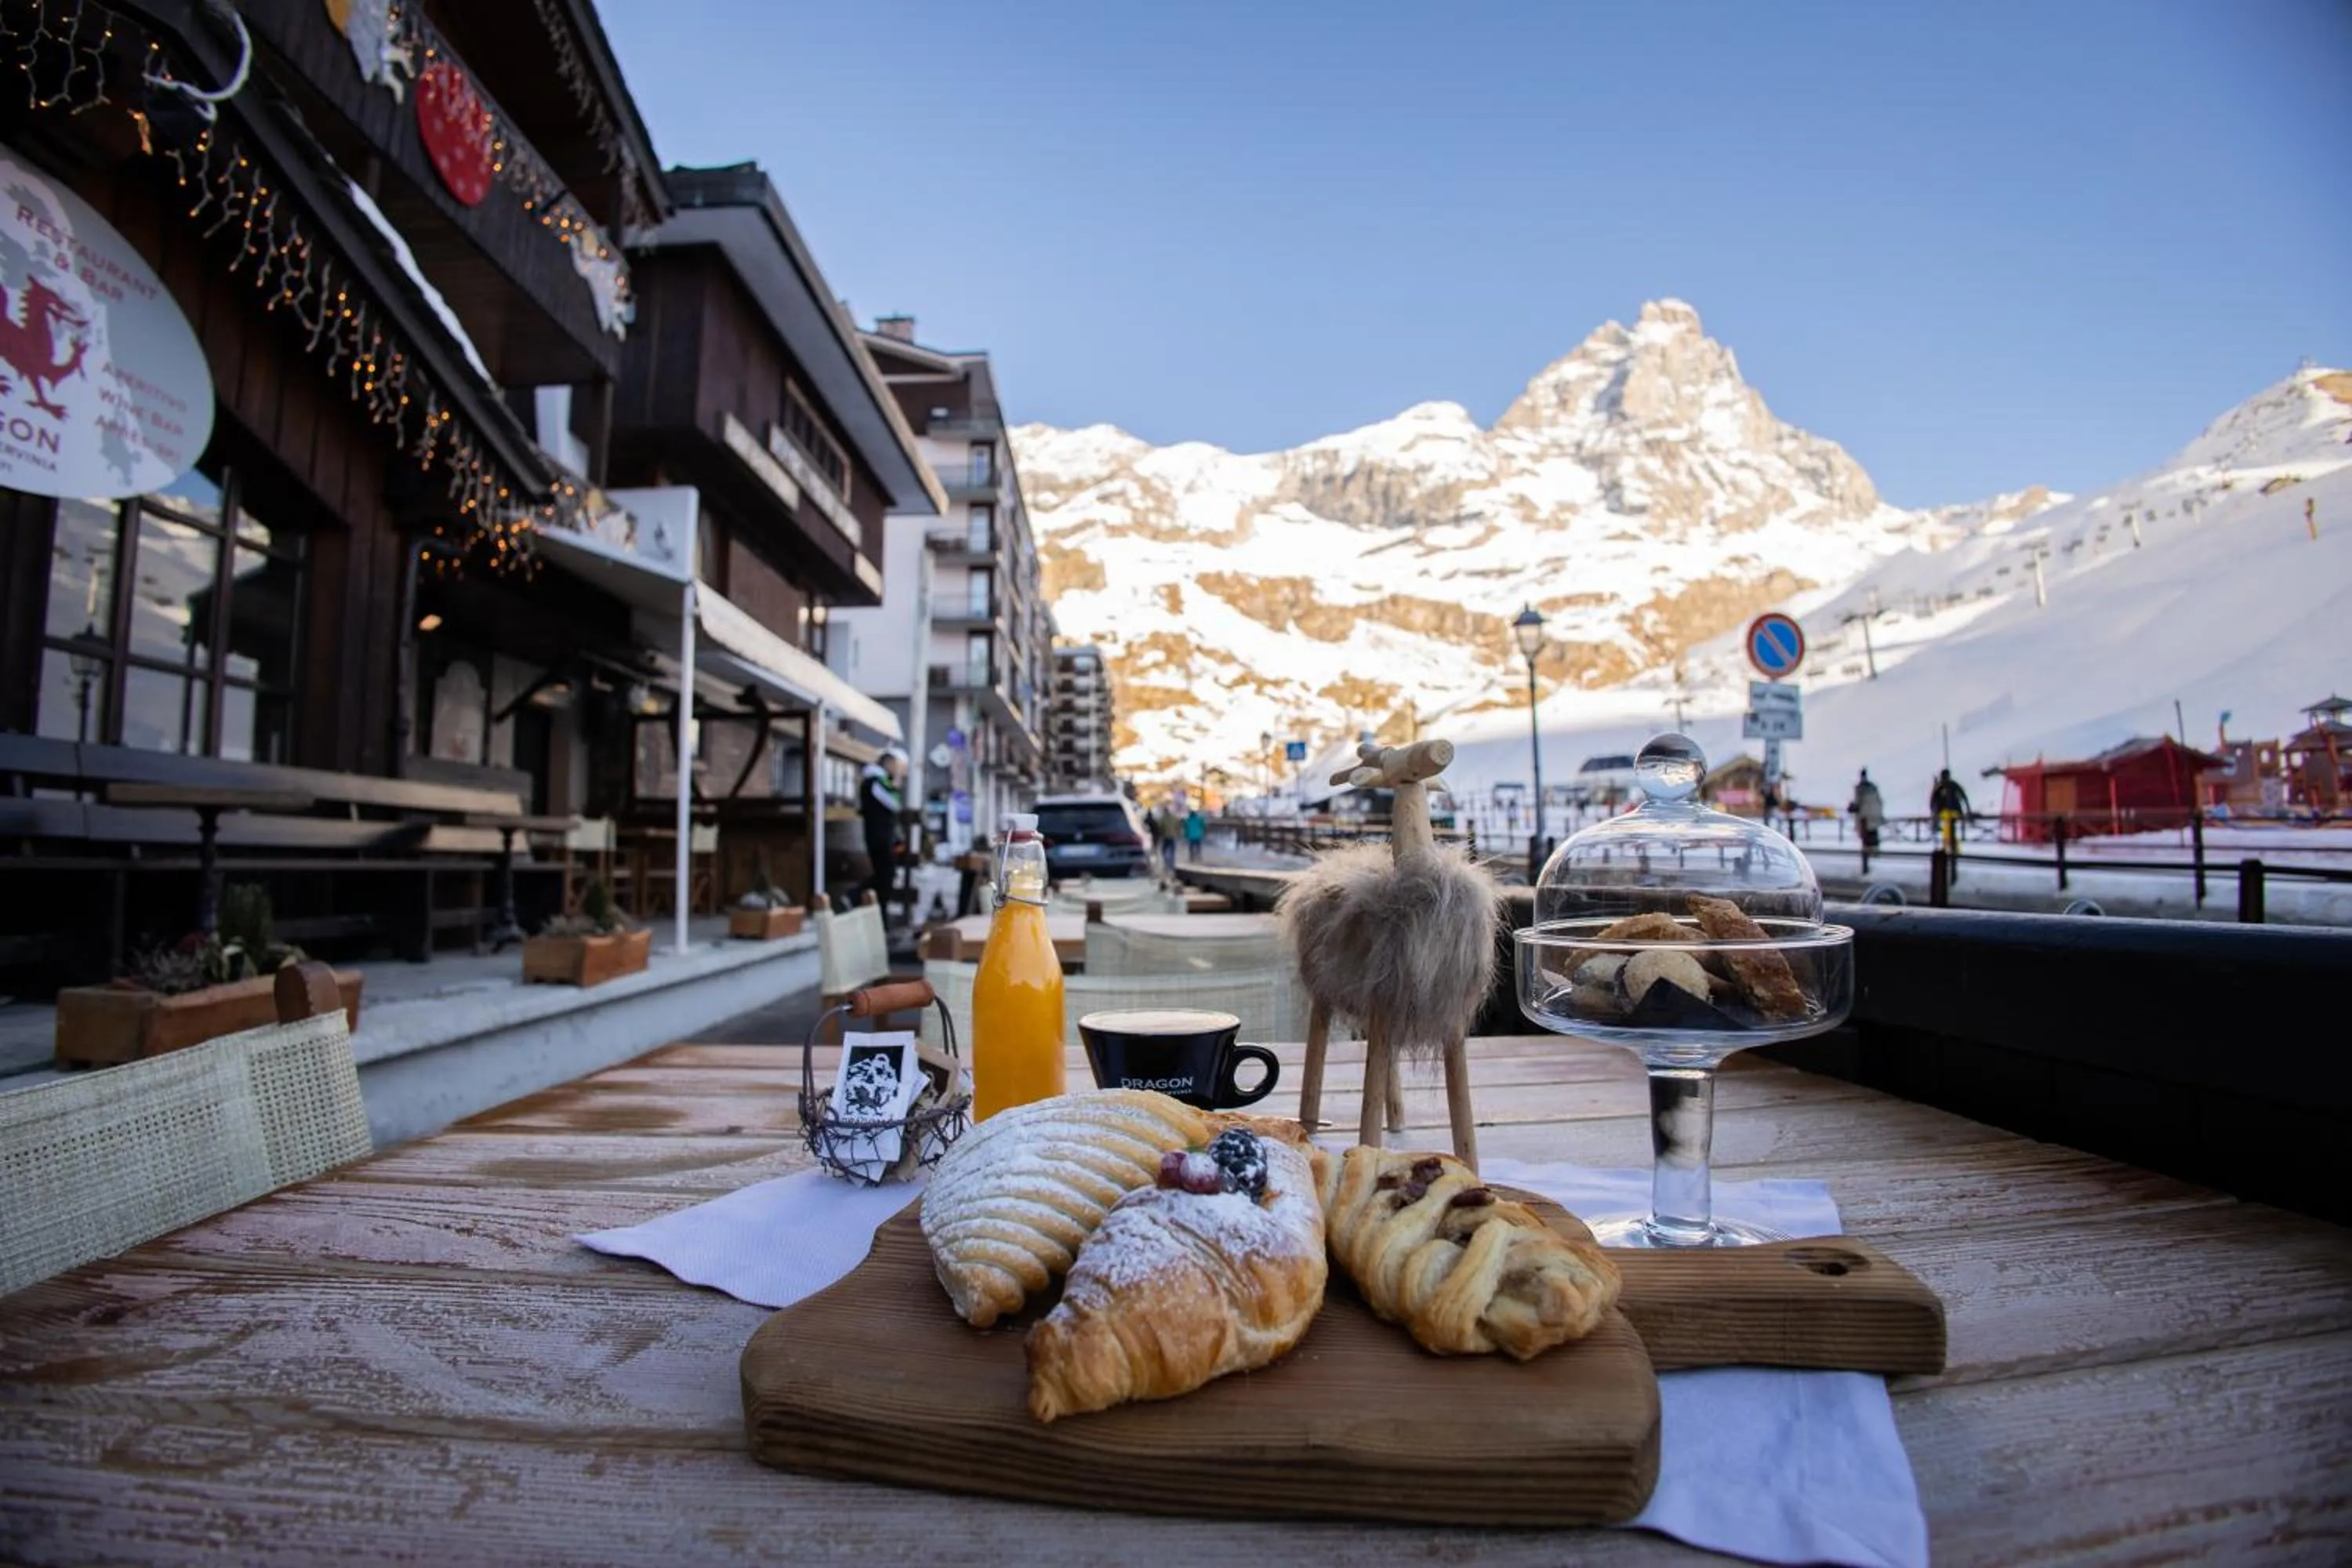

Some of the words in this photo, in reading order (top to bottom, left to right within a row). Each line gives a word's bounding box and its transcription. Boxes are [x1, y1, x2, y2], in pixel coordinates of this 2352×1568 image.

[16, 205, 158, 299] RESTAURANT
[54, 252, 71, 271] &
[80, 266, 125, 303] BAR
[1120, 1076, 1193, 1089] DRAGON
